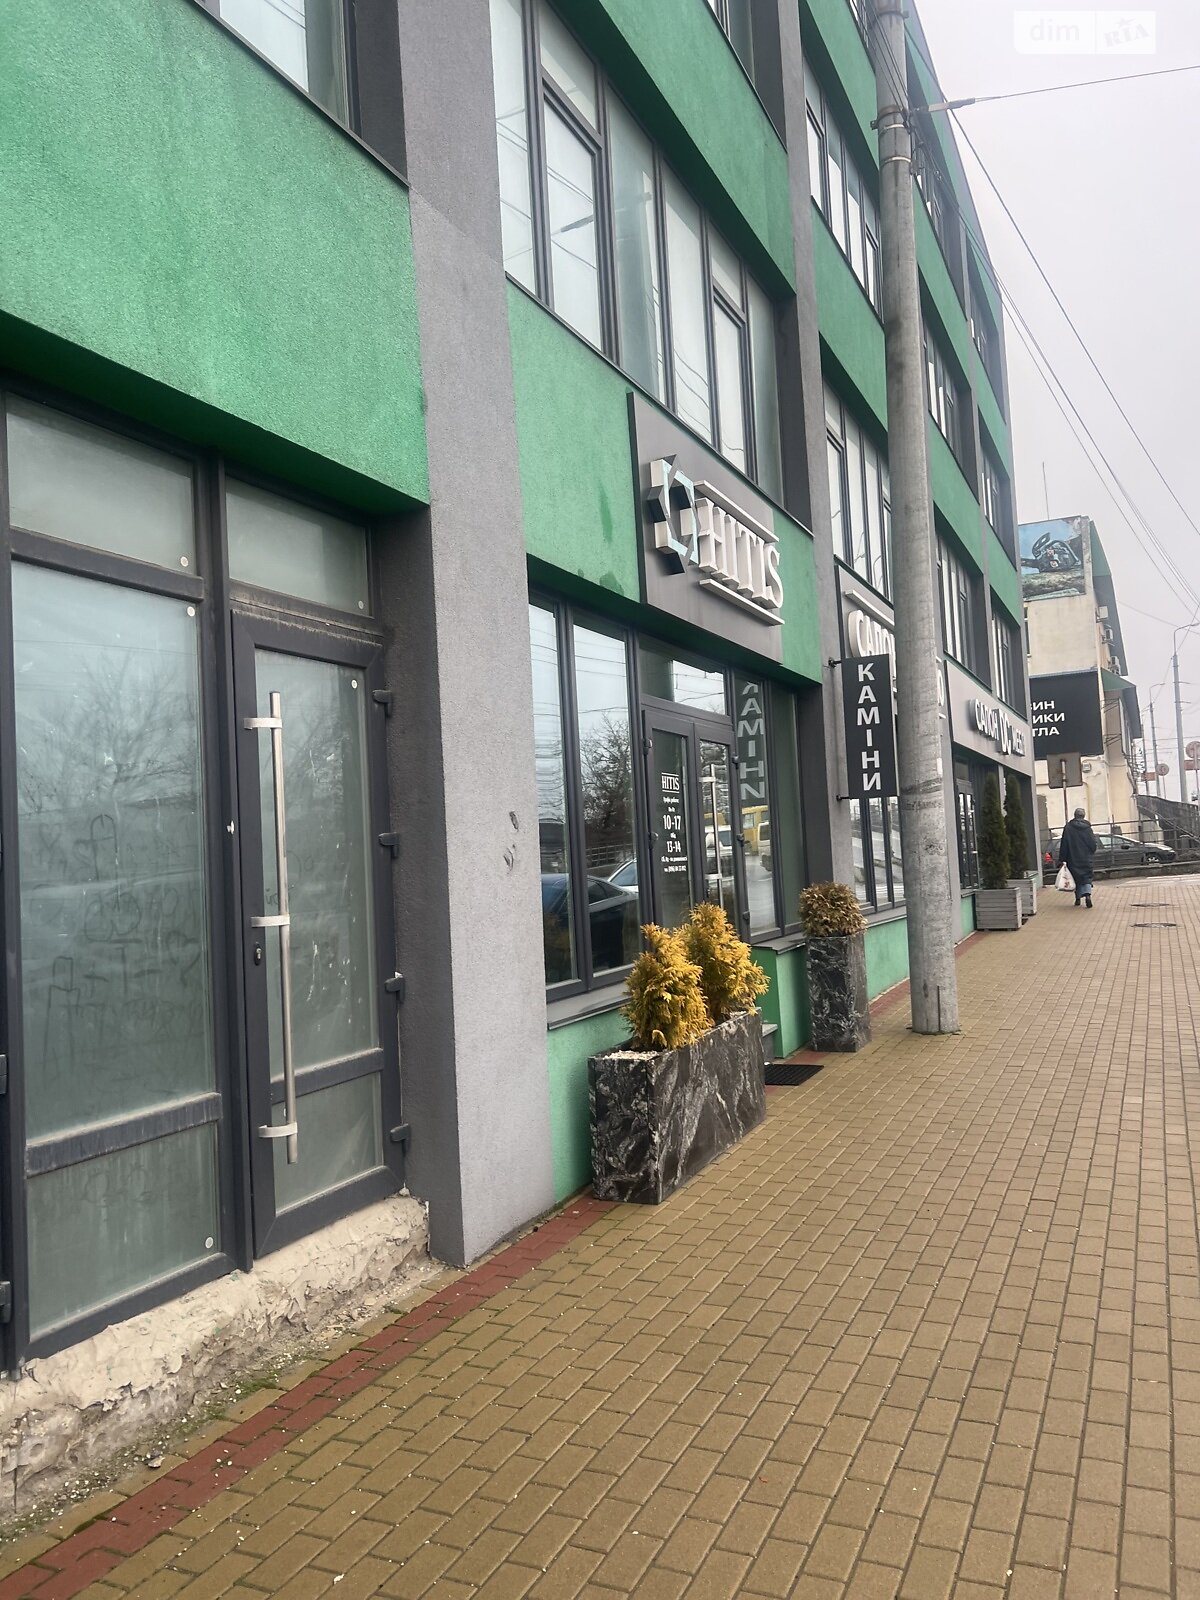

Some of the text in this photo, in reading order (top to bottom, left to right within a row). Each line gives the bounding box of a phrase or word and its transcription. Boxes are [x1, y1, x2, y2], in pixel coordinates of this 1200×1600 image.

[694, 497, 784, 609] HITIS
[1029, 700, 1055, 711] ИН
[856, 661, 882, 792] КАМІНИ
[973, 698, 1000, 741] САЛОН
[661, 775, 680, 791] HITIS
[662, 814, 682, 831] 10-17
[666, 840, 682, 853] 13-14
